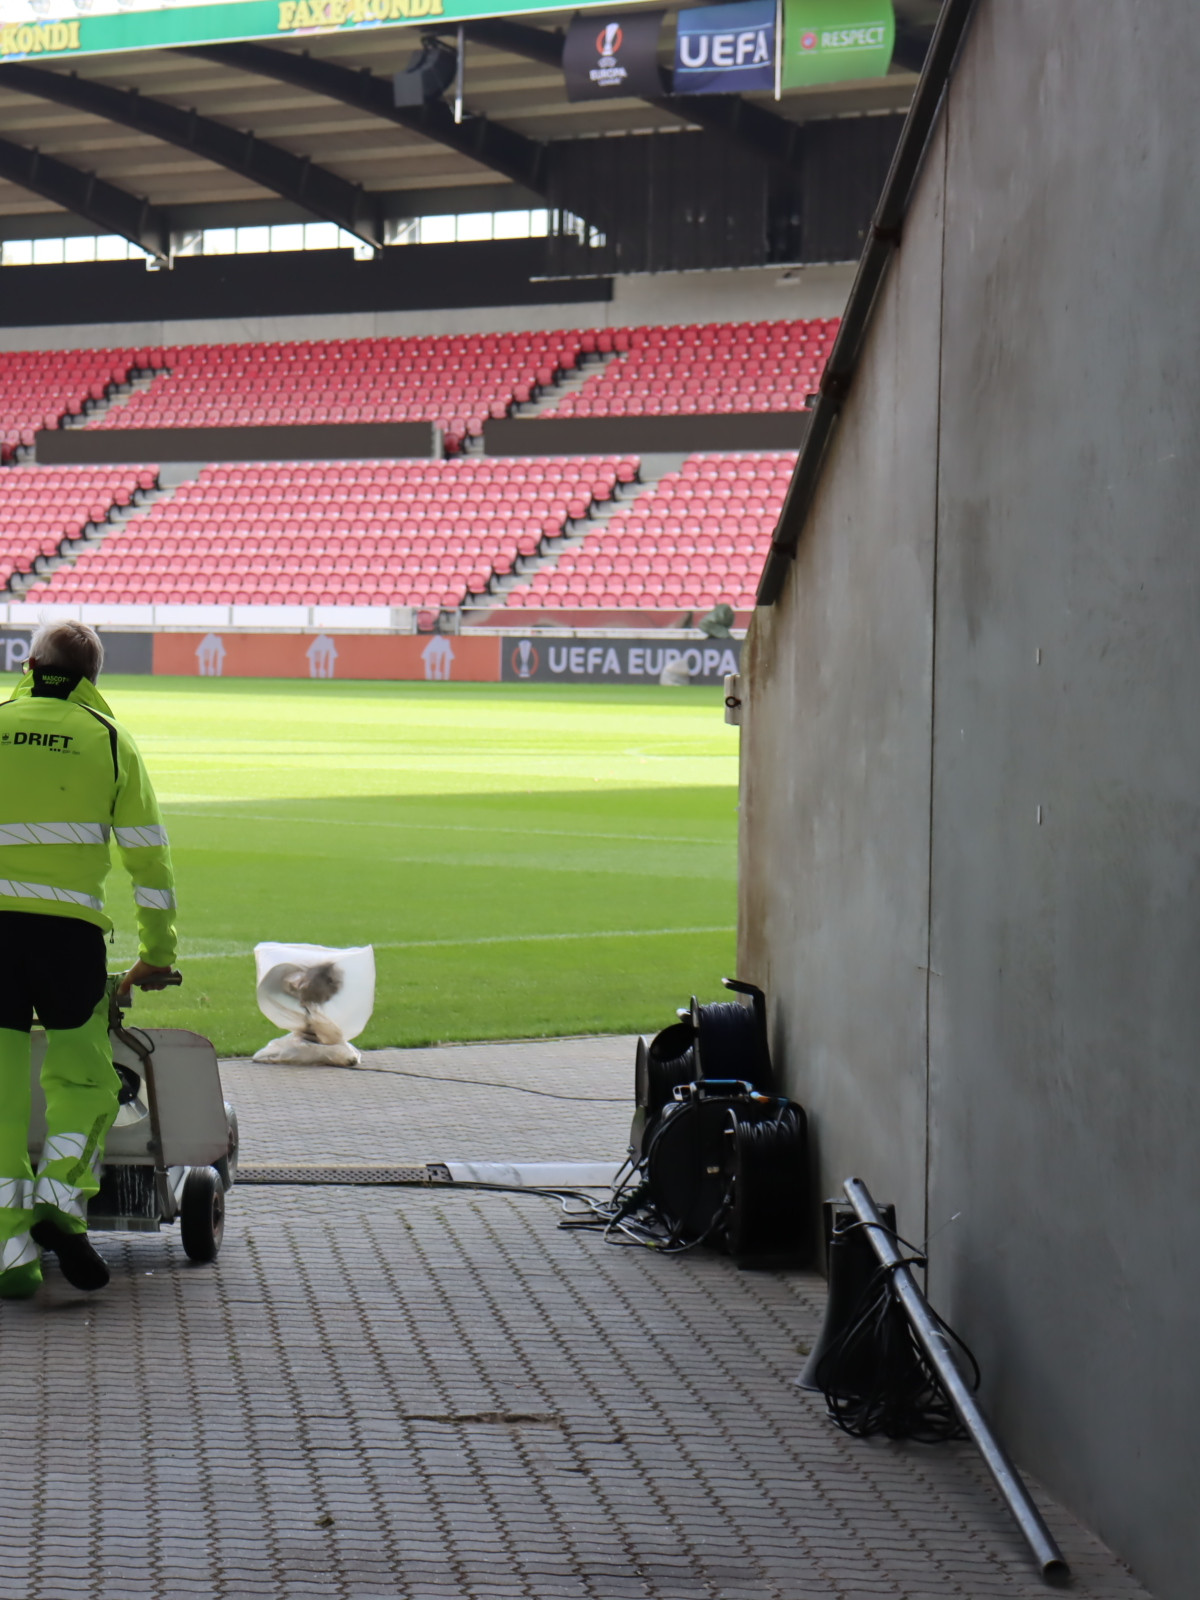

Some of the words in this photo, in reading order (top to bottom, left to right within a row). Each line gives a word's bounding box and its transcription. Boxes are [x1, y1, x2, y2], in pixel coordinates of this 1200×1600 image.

[278, 0, 347, 30] FAXE
[352, 0, 443, 23] KONDI
[0, 22, 80, 55] KONDI
[679, 30, 768, 67] UEFA
[821, 27, 885, 48] RESPECT
[548, 647, 621, 674] UEFA
[14, 732, 74, 749] DRIFT
